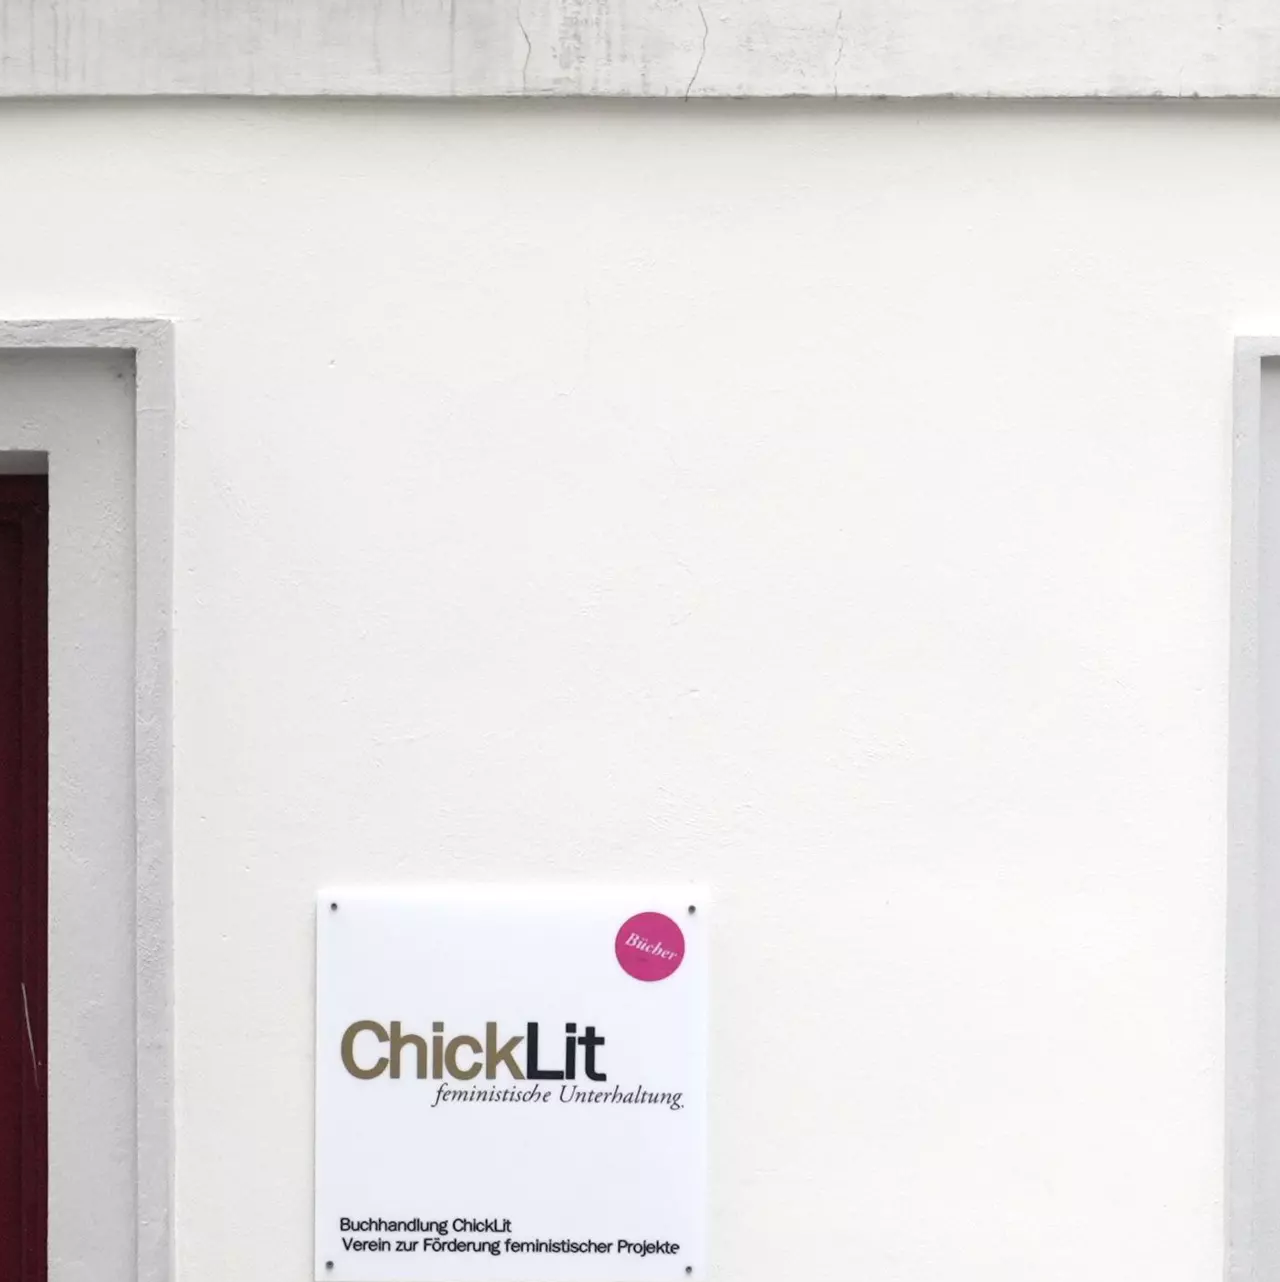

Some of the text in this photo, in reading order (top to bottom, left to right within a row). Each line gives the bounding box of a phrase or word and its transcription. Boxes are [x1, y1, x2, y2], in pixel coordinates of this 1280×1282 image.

[624, 932, 678, 960] Bücher
[340, 1020, 607, 1082] ChickLit
[431, 1082, 685, 1111] feministische Unterhaltung.
[339, 1217, 512, 1236] Buchhandlung ChickLit
[341, 1237, 681, 1257] Verein zur Förderung feministischer Projekte
